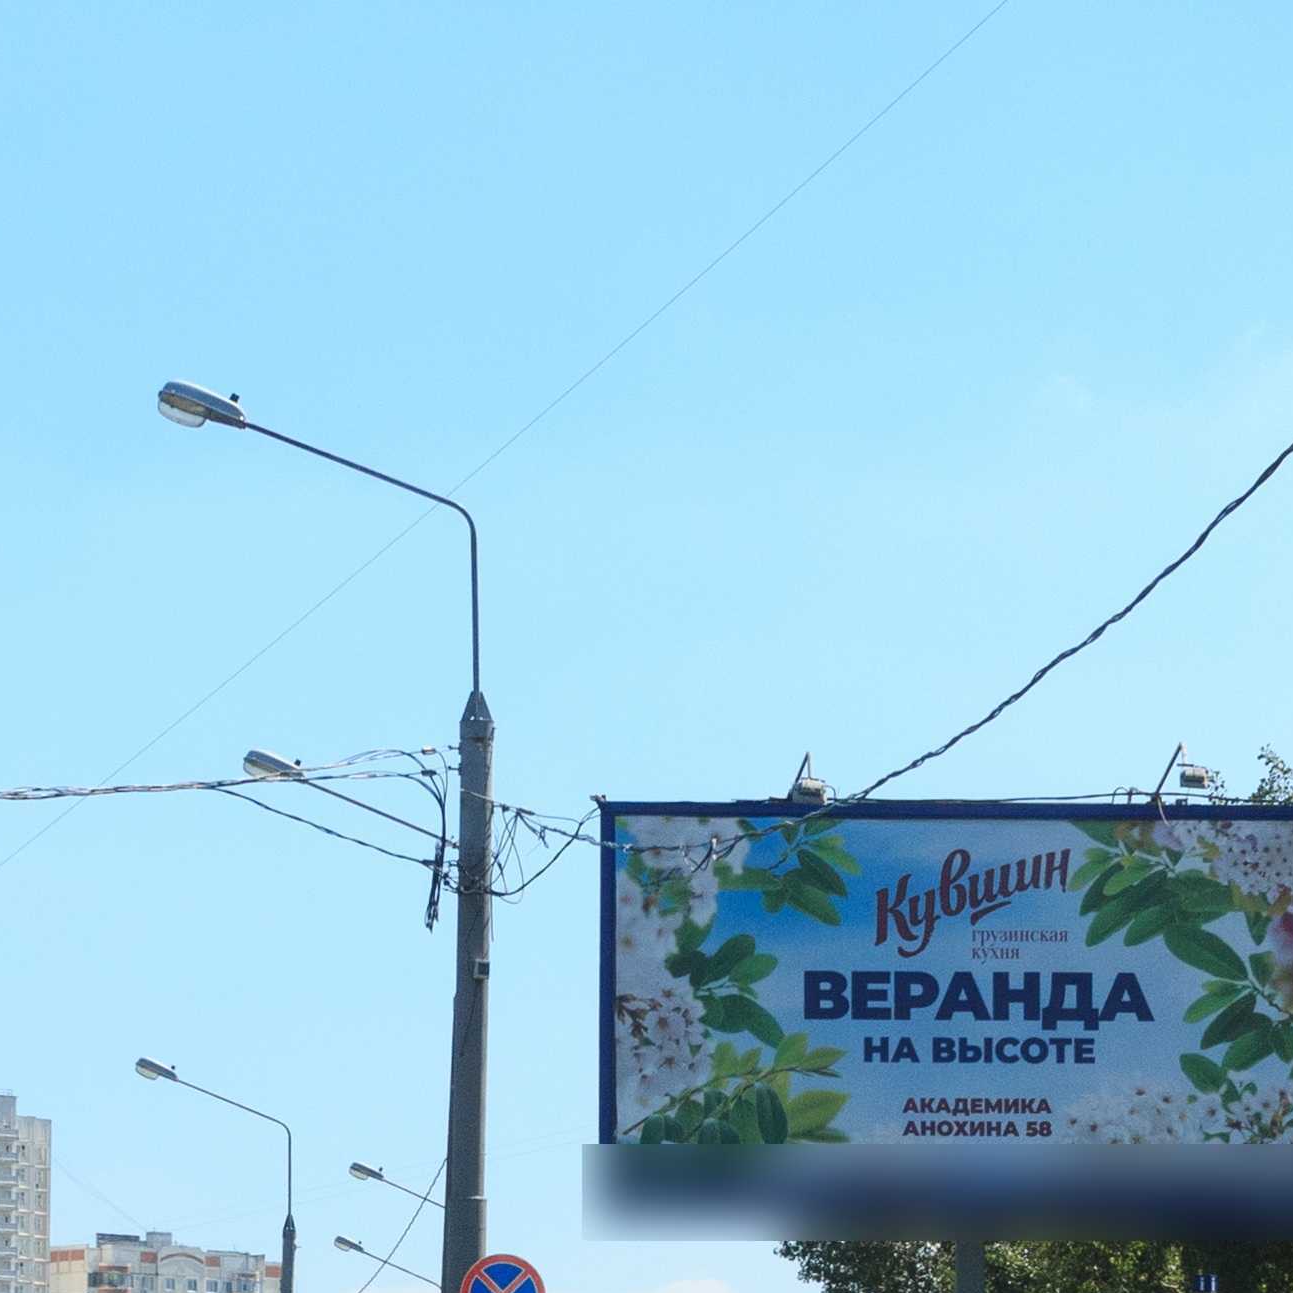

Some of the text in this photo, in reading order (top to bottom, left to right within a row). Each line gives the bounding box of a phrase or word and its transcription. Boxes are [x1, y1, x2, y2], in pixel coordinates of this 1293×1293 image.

[875, 848, 1071, 958] Кувшин
[971, 928, 1069, 944] грузинская
[971, 947, 1021, 964] кухня
[803, 970, 1156, 1031] ВЕРАНДА
[863, 1036, 1096, 1064] НА ВЫСОТЕ
[902, 1097, 1052, 1117] АКАДЕМИКА
[902, 1120, 1052, 1138] АНОХИНА 58
